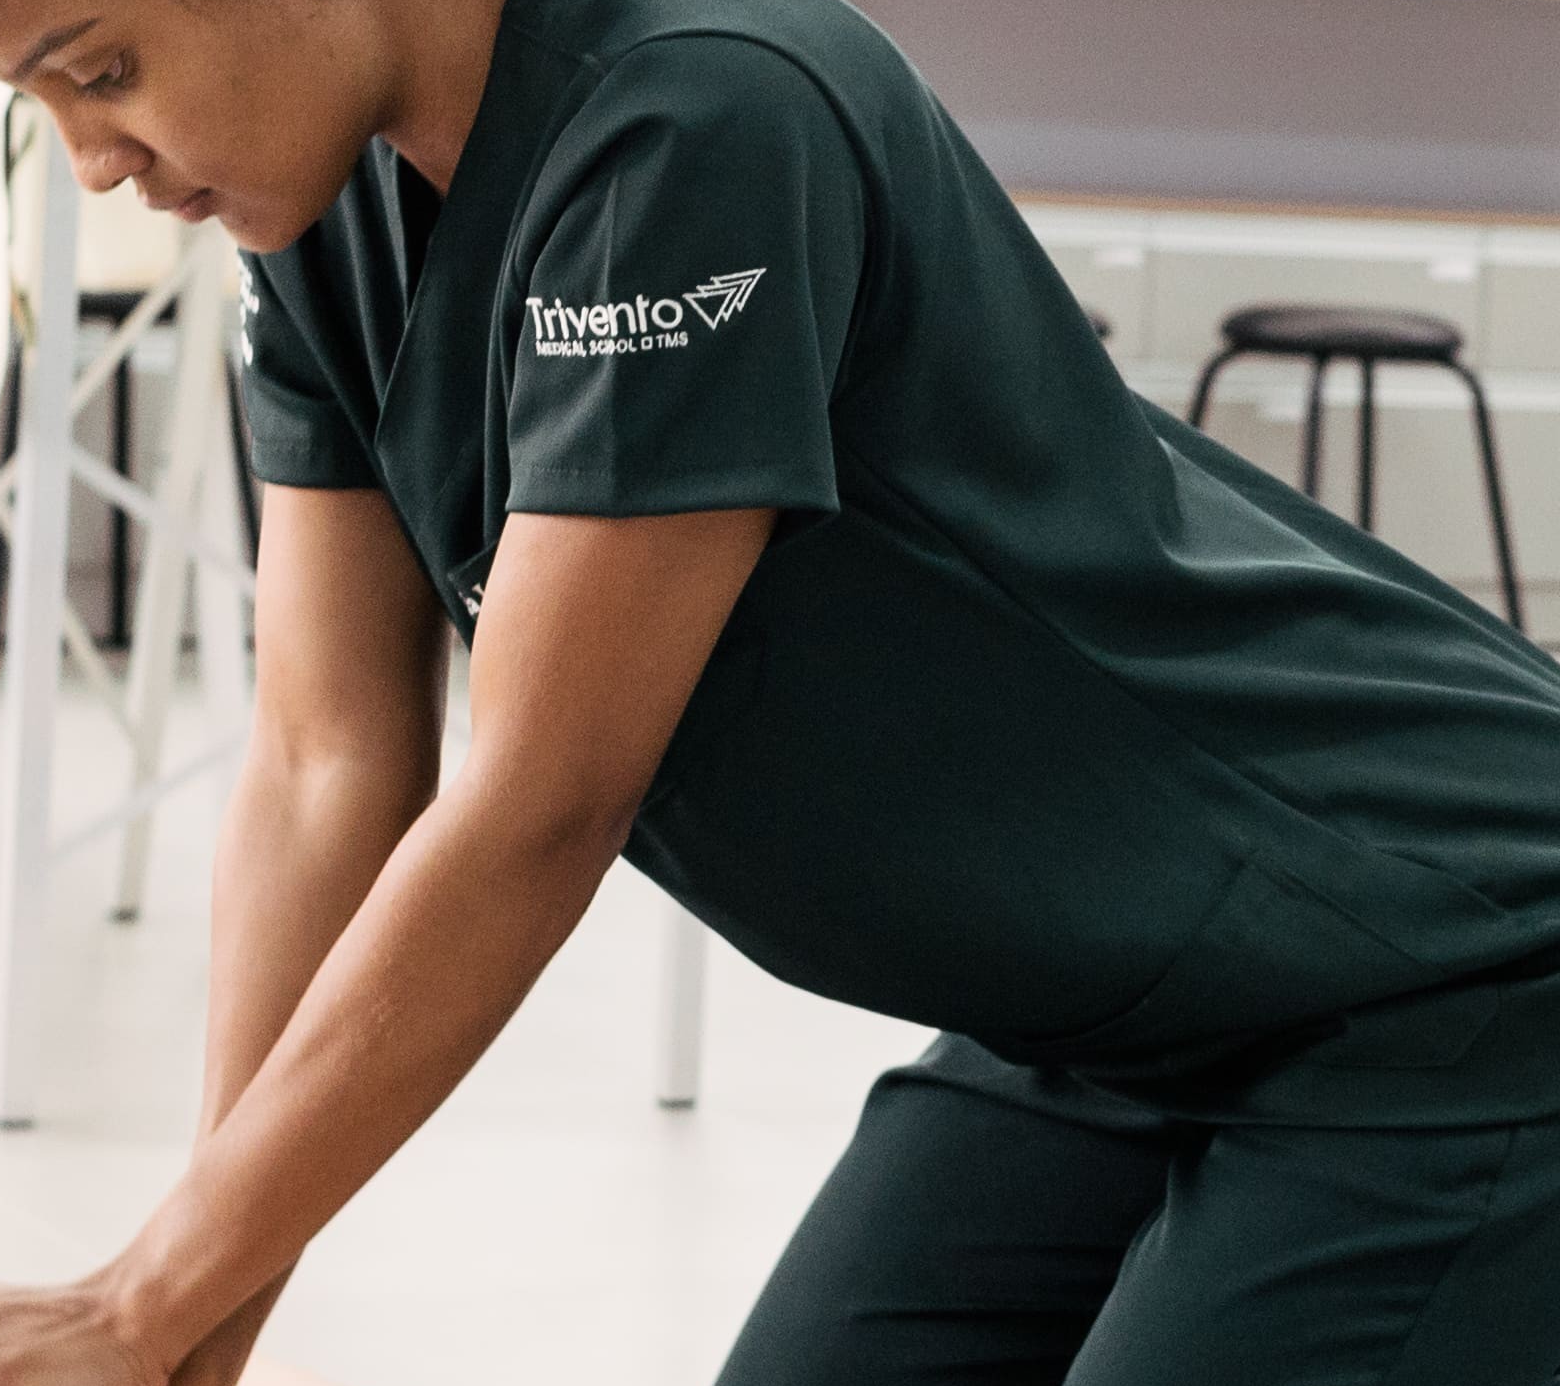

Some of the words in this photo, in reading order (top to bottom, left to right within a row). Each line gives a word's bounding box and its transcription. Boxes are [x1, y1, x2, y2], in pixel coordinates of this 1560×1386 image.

[525, 294, 683, 340] Trivento
[536, 339, 587, 357] MEDICAL
[657, 331, 689, 349] TMS
